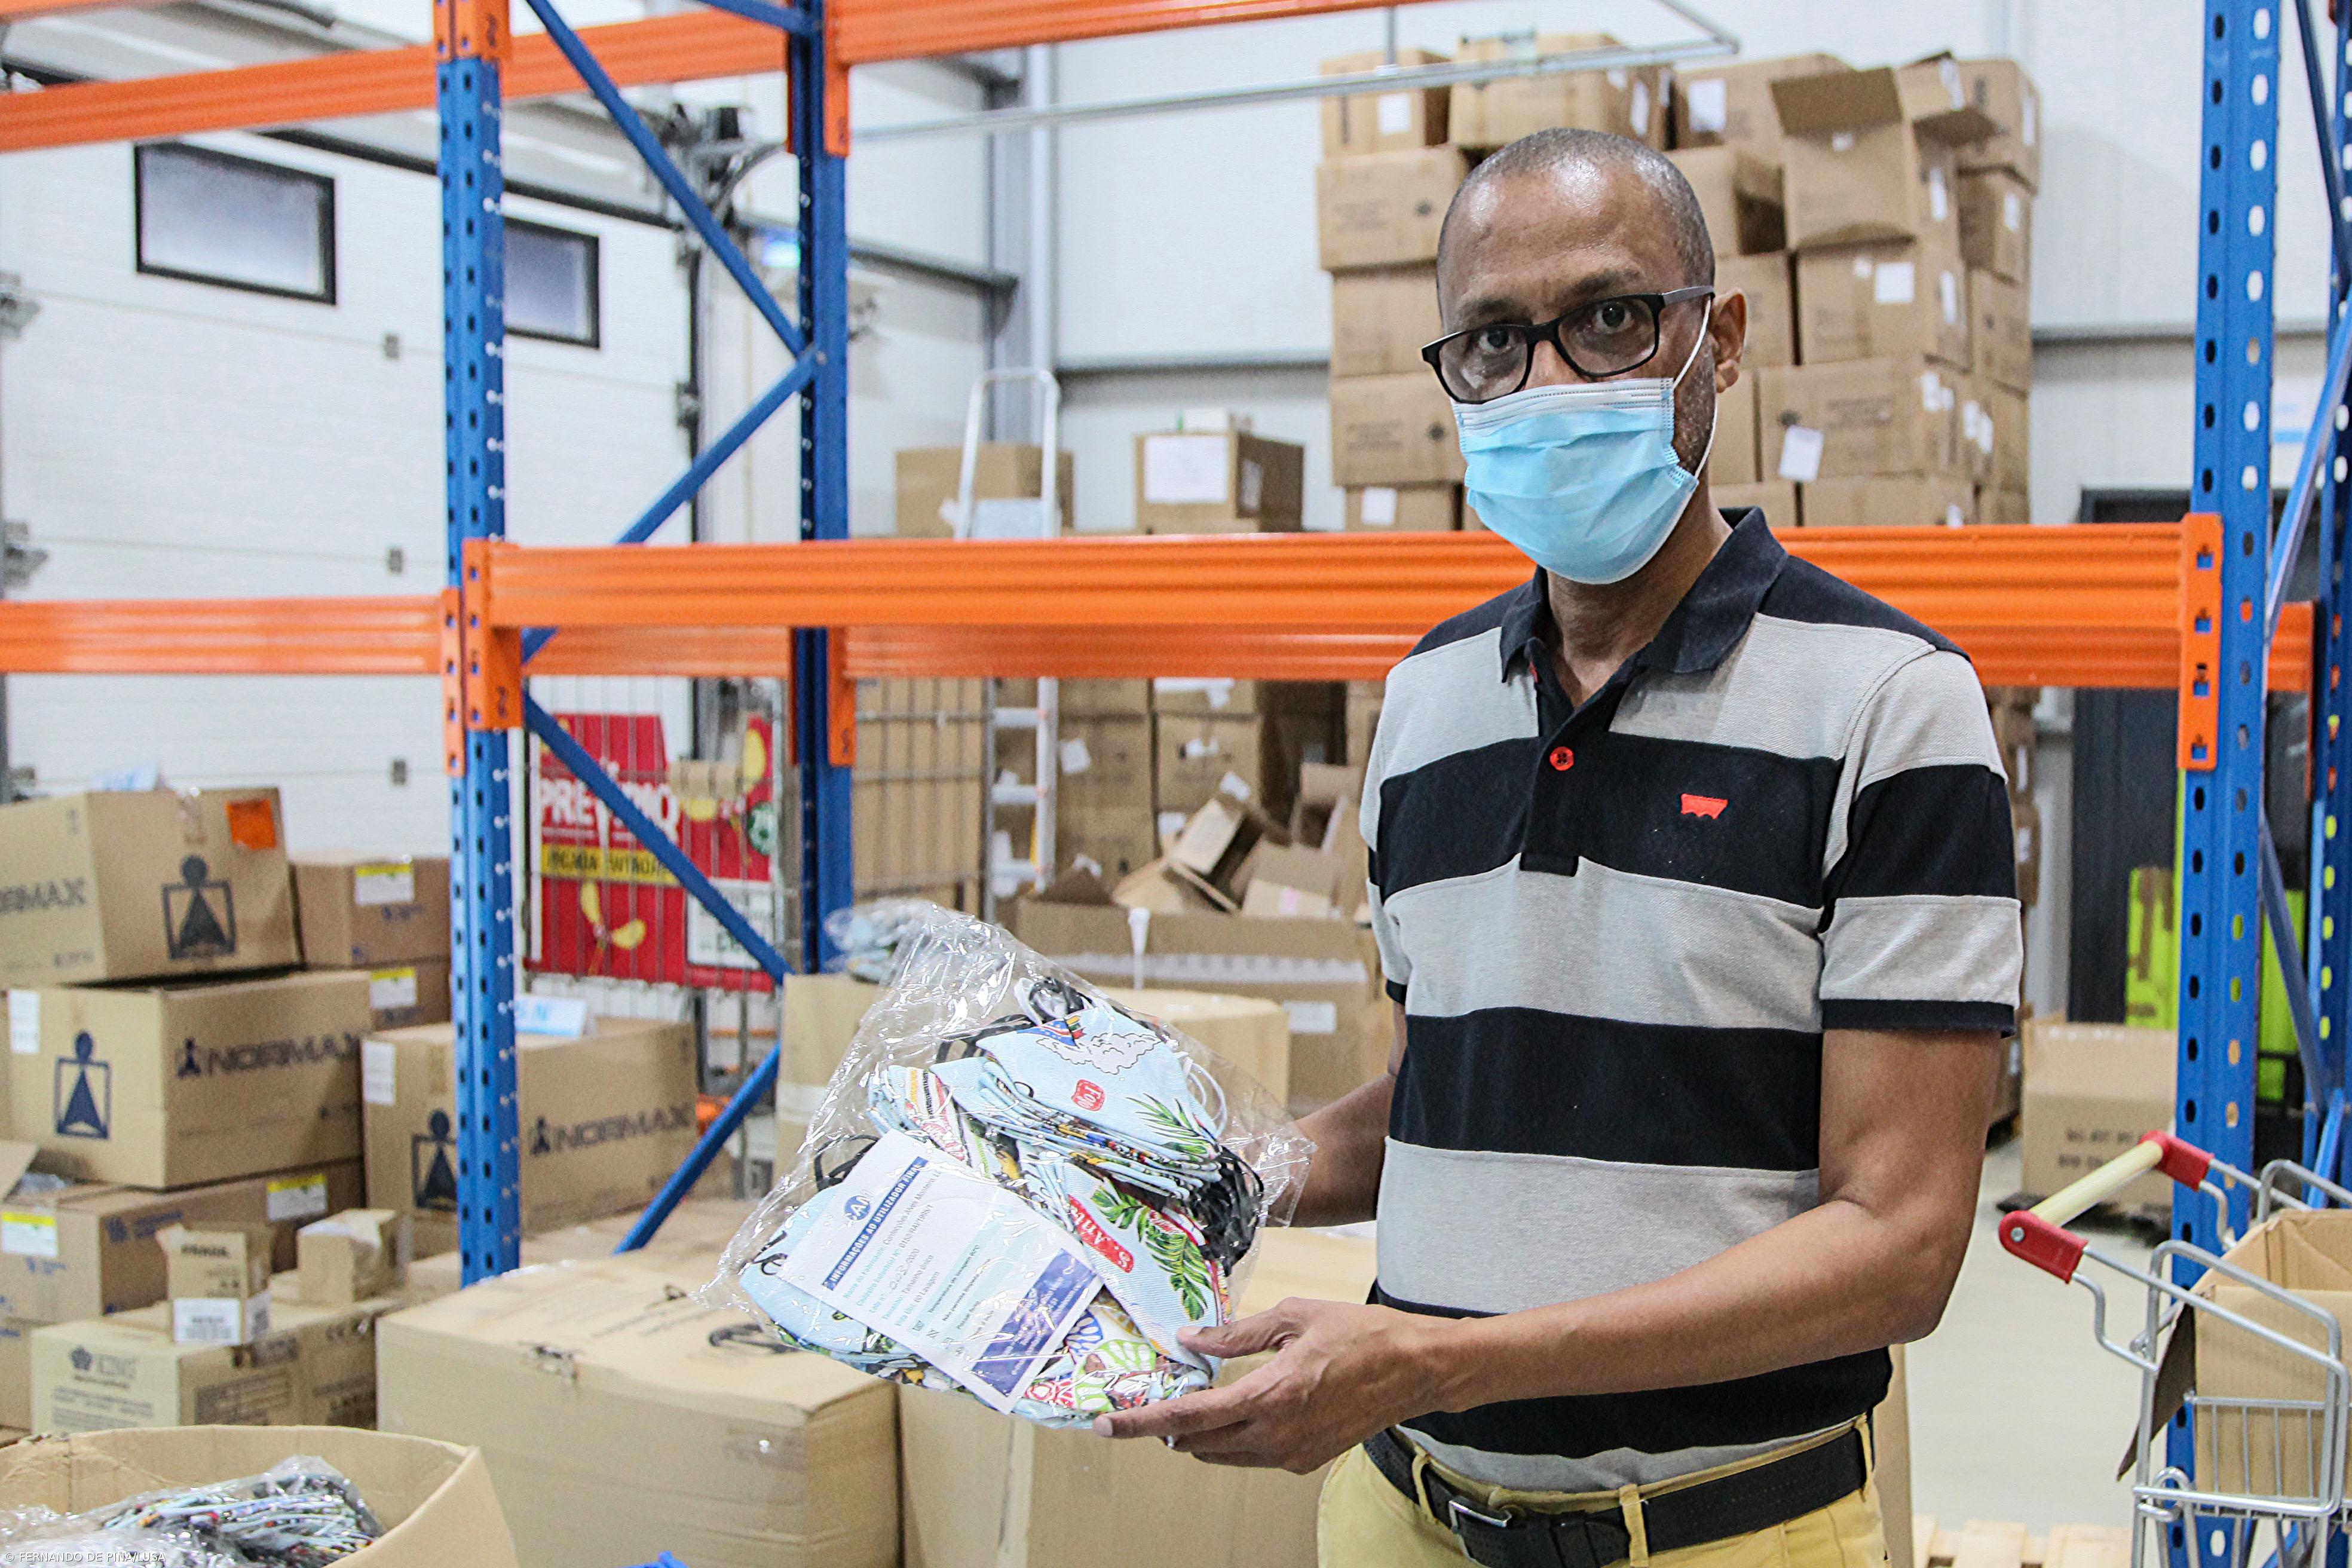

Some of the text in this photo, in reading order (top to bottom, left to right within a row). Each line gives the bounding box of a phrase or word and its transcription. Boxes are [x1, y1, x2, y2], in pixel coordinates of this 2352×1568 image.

[553, 1101, 691, 1152] NORMAX
[829, 1233, 870, 1283] INFORMAÇÕES
[865, 1221, 877, 1234] AO
[872, 1180, 908, 1224] UTILIZADOR
